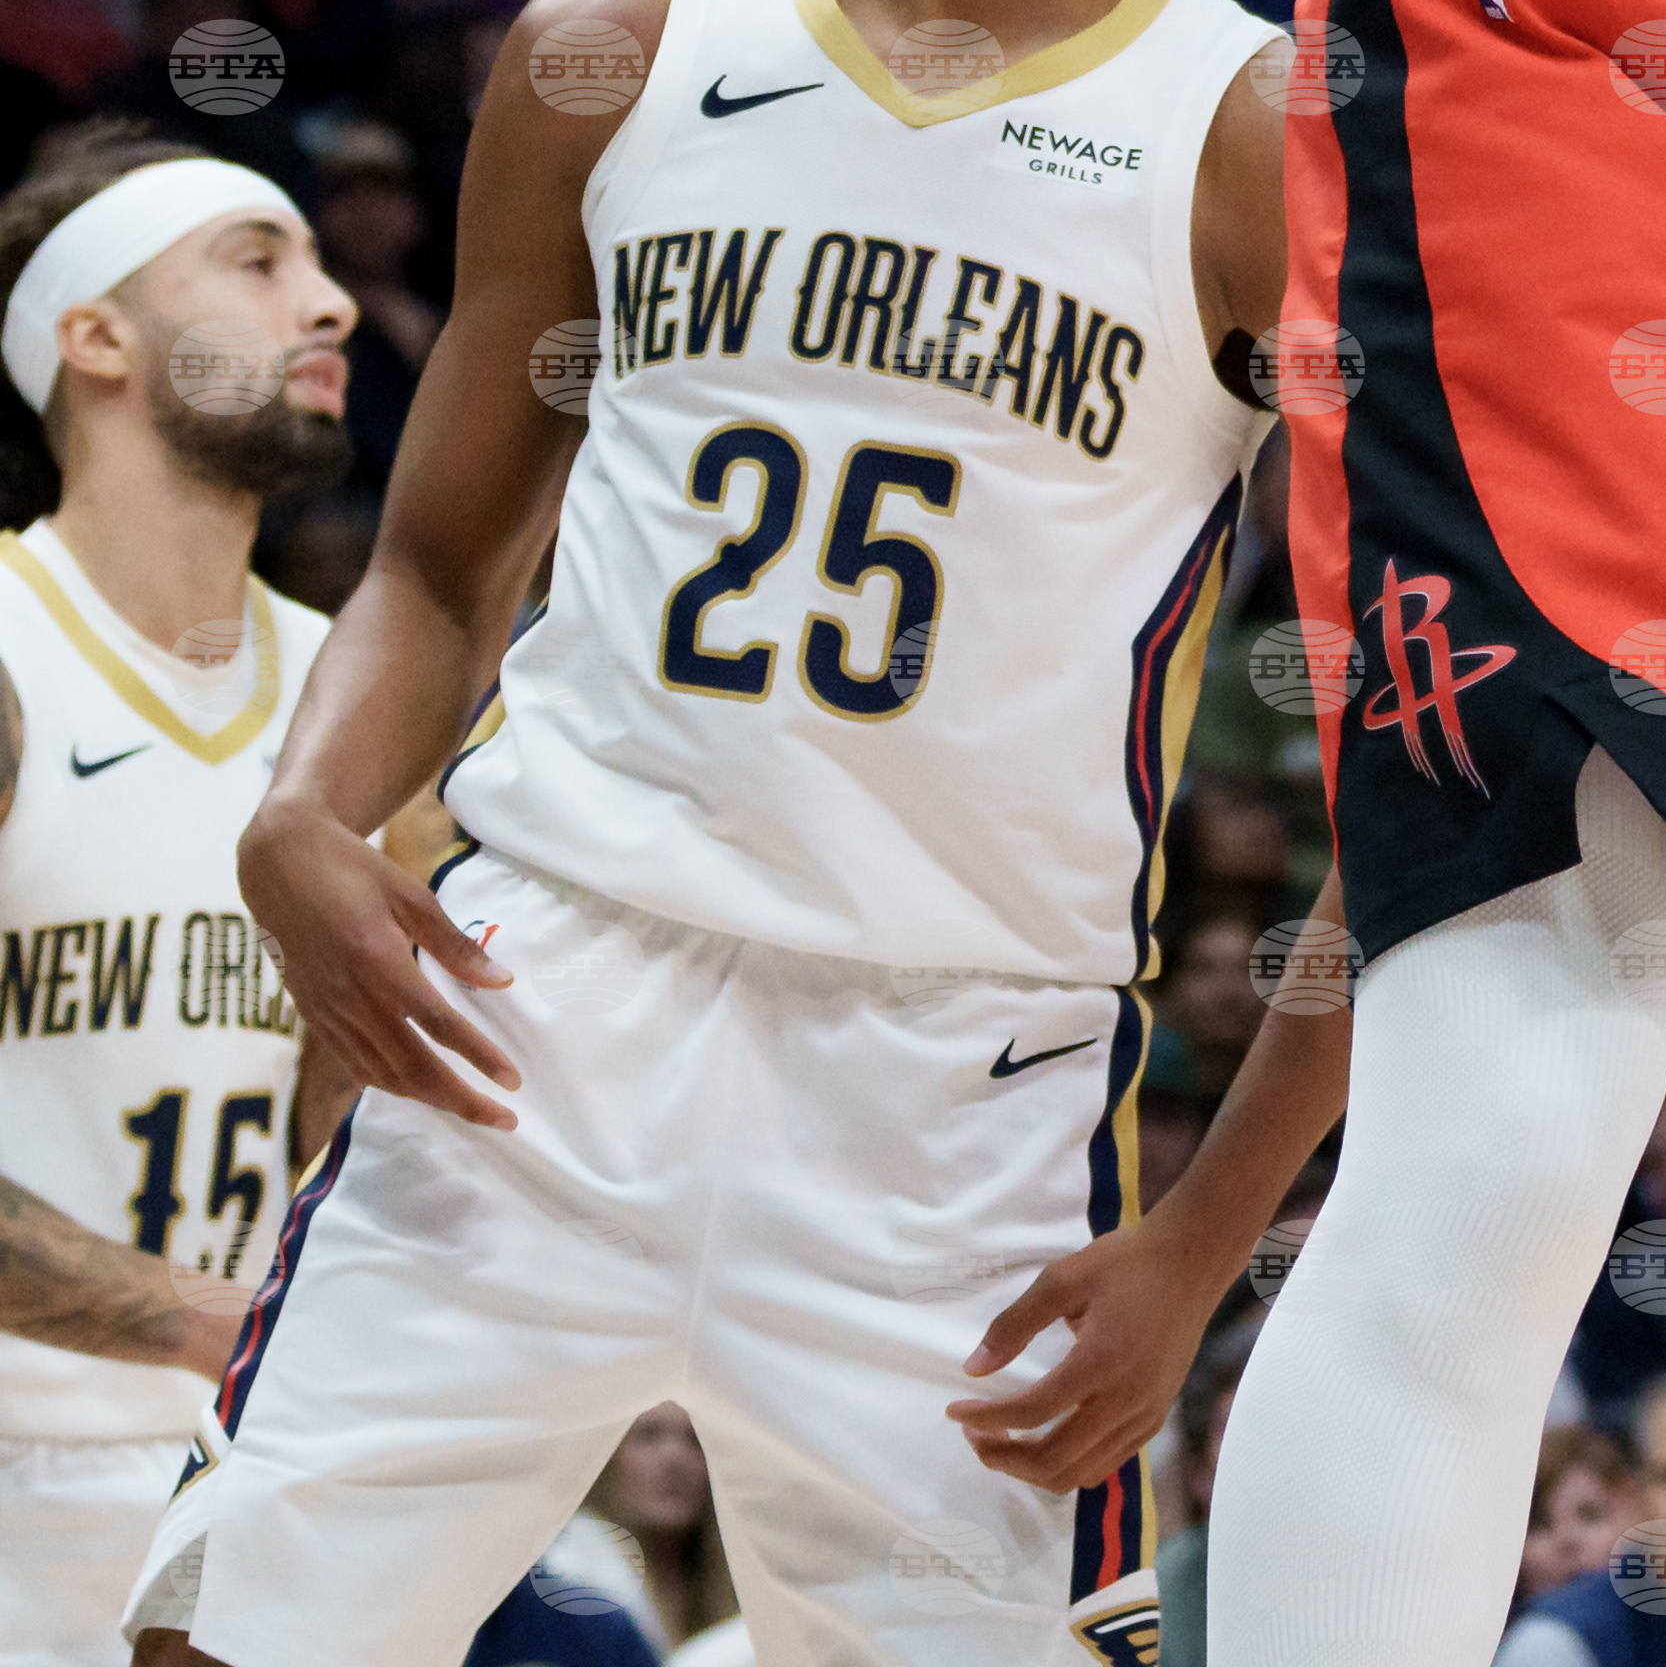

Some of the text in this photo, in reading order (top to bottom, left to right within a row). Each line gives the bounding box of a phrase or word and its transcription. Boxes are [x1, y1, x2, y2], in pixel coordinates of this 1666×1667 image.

[1001, 119, 1143, 170] NEWAGE
[1028, 158, 1103, 185] GRILLS
[612, 227, 1145, 463] NEW ORLEANS
[658, 420, 963, 721] 25
[0, 913, 161, 1039] NEW
[121, 1085, 275, 1281] 15
